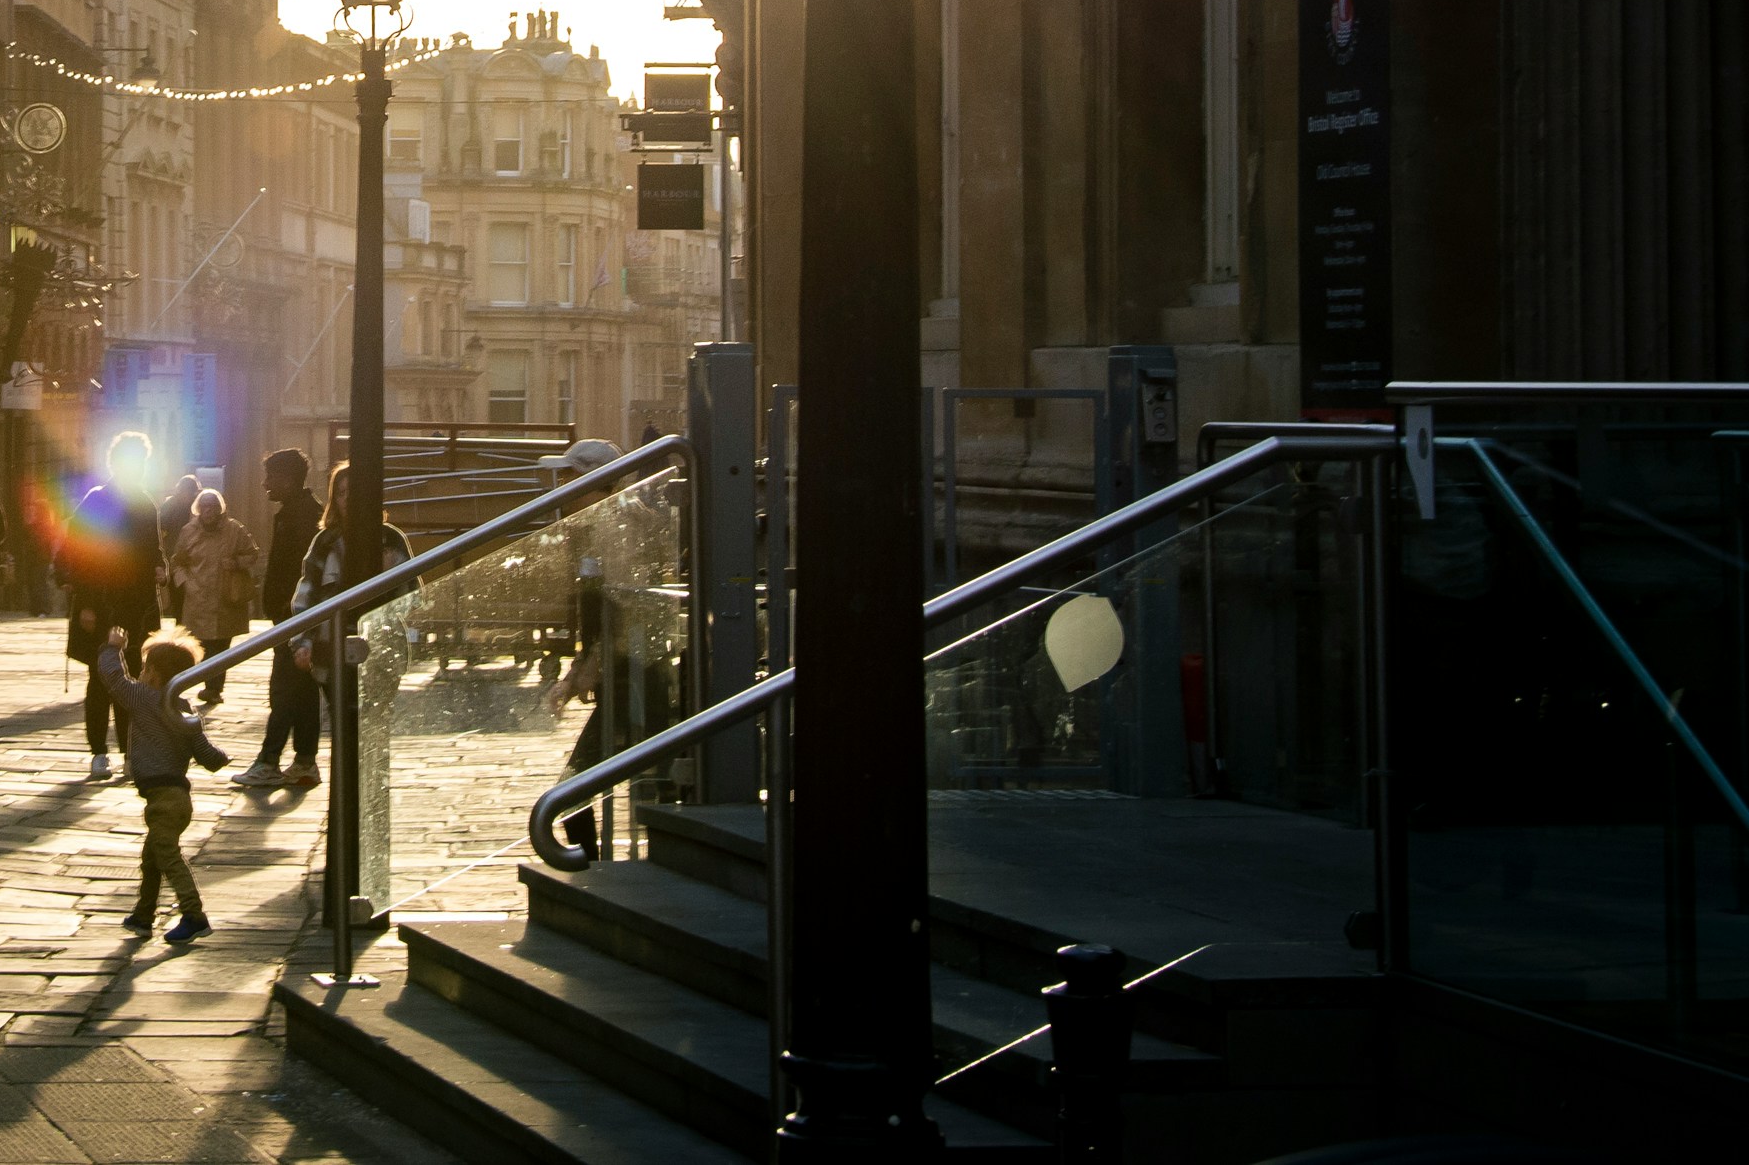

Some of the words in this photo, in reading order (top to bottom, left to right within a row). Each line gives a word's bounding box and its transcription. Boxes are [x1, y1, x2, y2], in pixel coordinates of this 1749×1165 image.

[650, 98, 704, 107] HARBOUR
[1308, 115, 1330, 133] Bristol
[1331, 113, 1357, 135] Register
[1358, 107, 1380, 127] Office
[642, 189, 701, 199] HARBOUR
